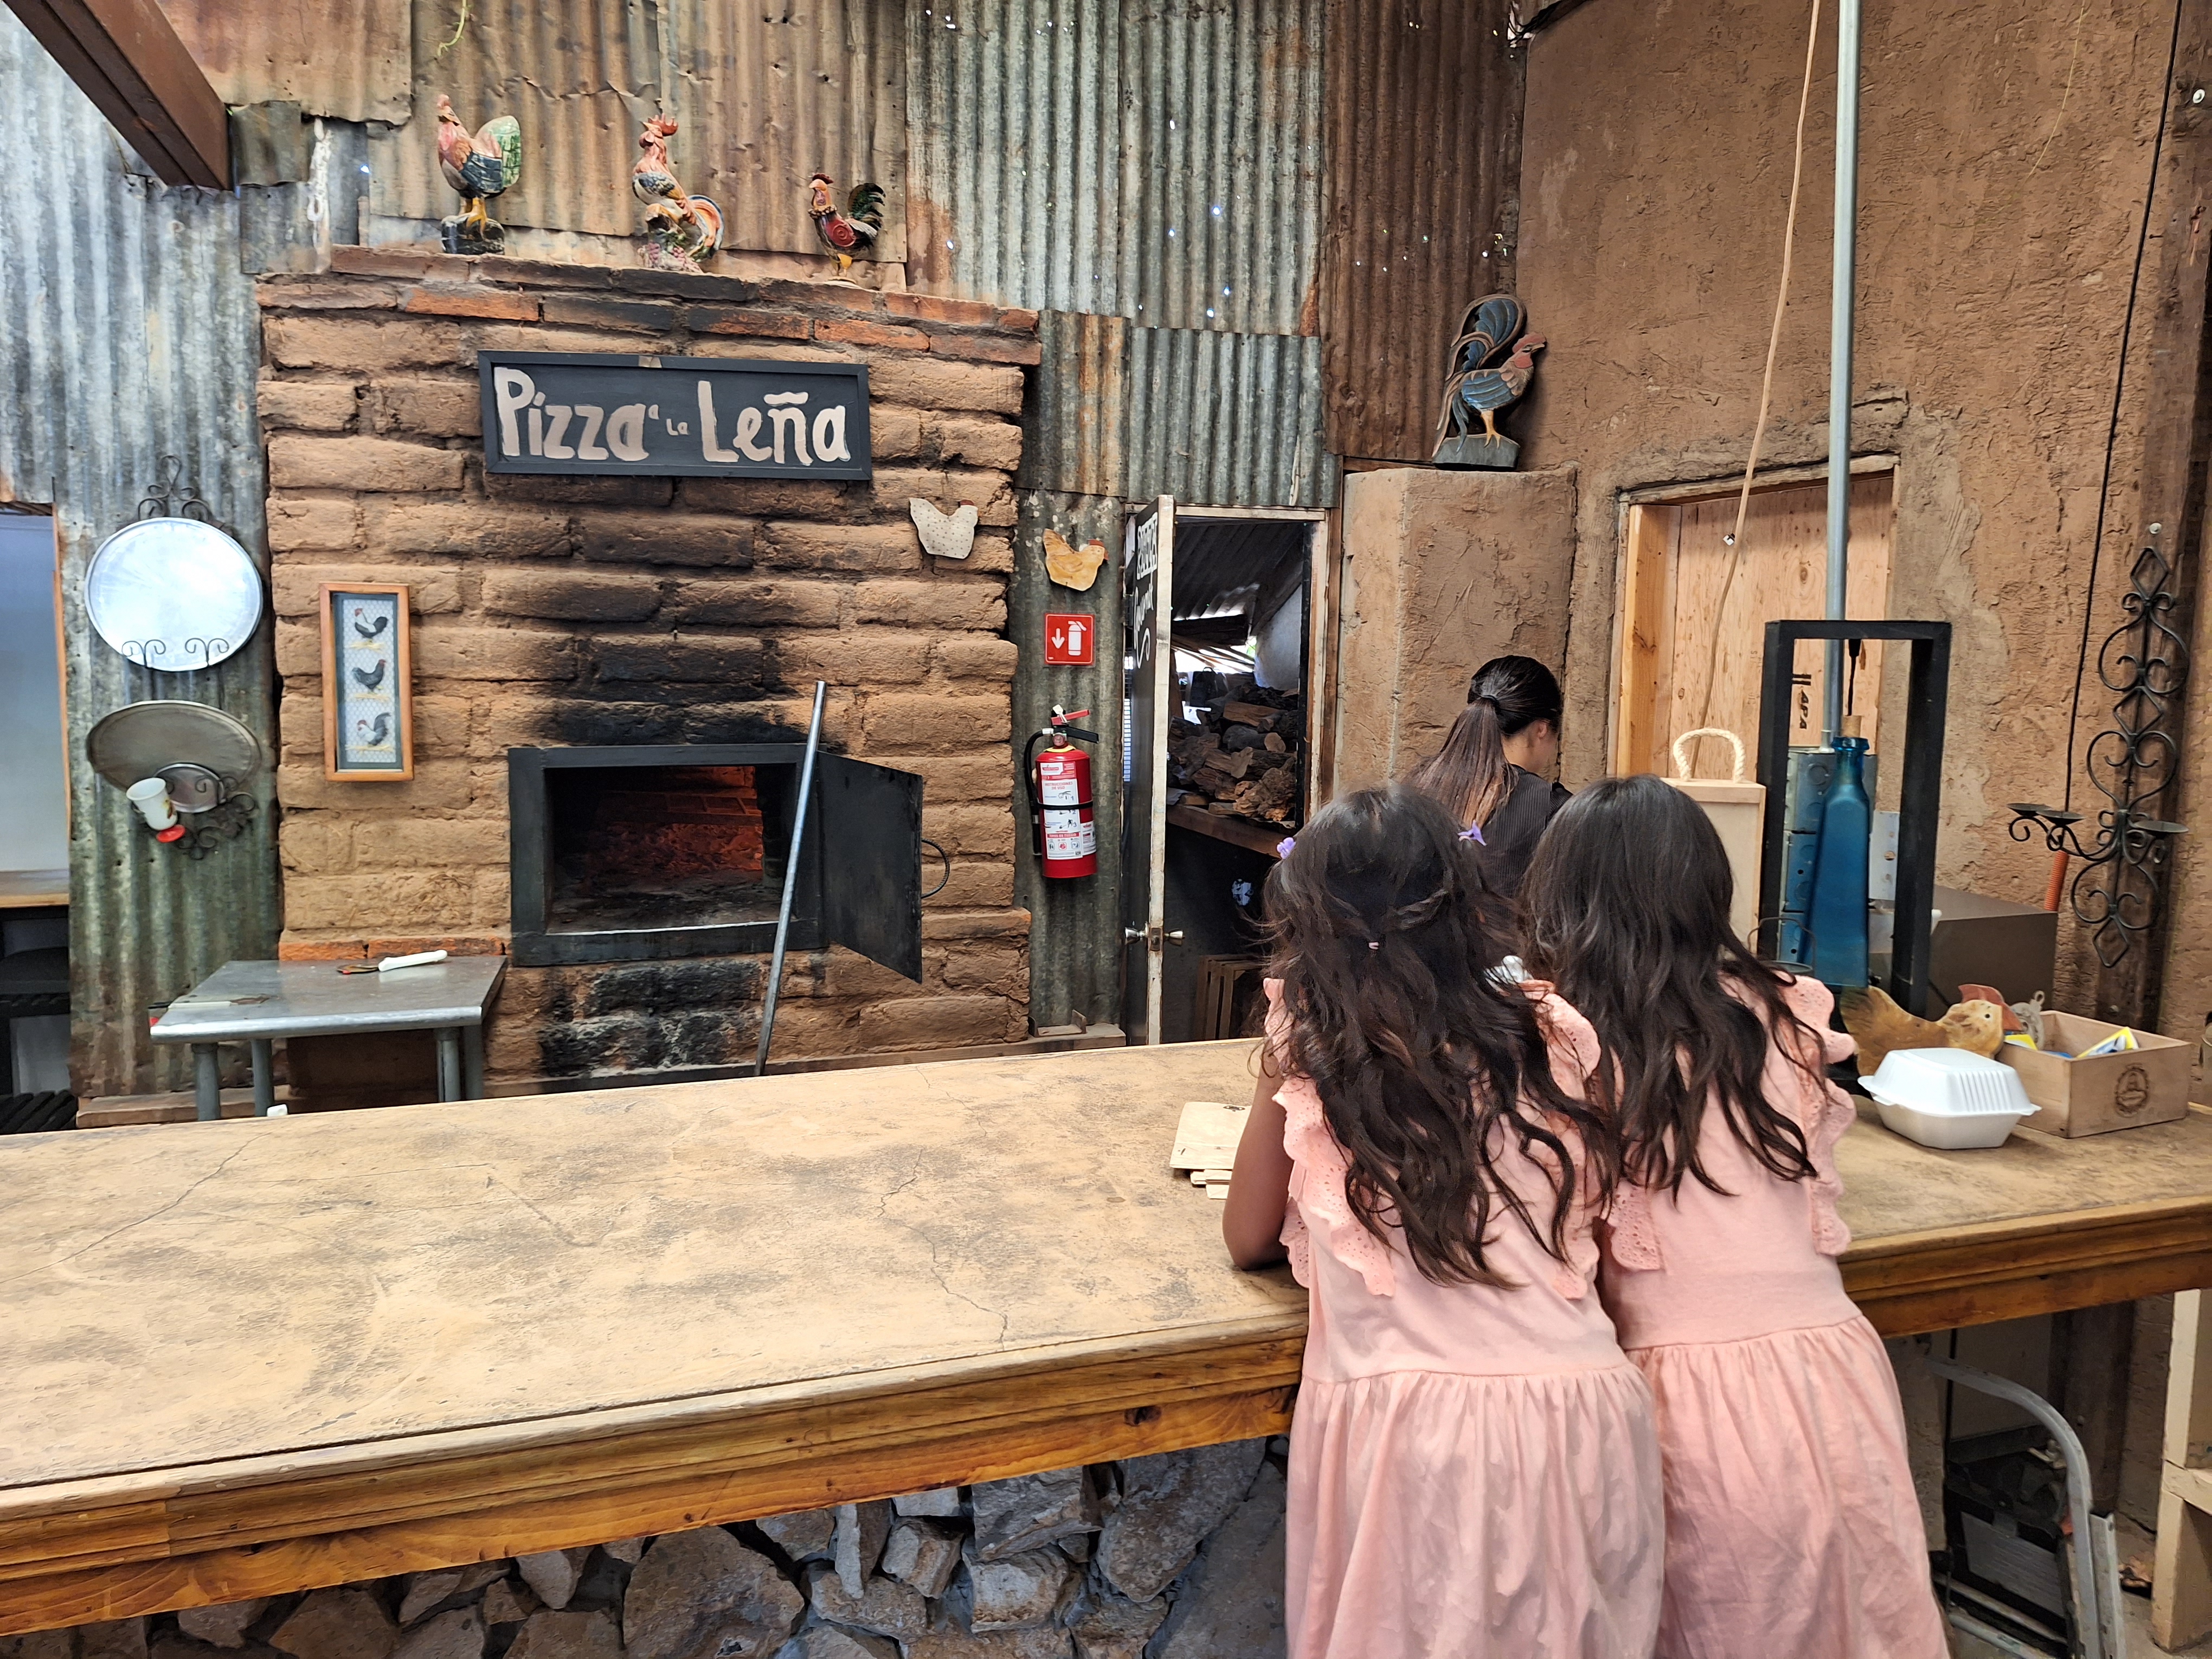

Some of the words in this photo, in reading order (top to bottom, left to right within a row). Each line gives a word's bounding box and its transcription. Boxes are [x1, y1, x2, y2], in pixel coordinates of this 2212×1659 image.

[494, 367, 649, 461] Pizza
[698, 381, 851, 465] Leña
[1799, 689, 1809, 729] APA
